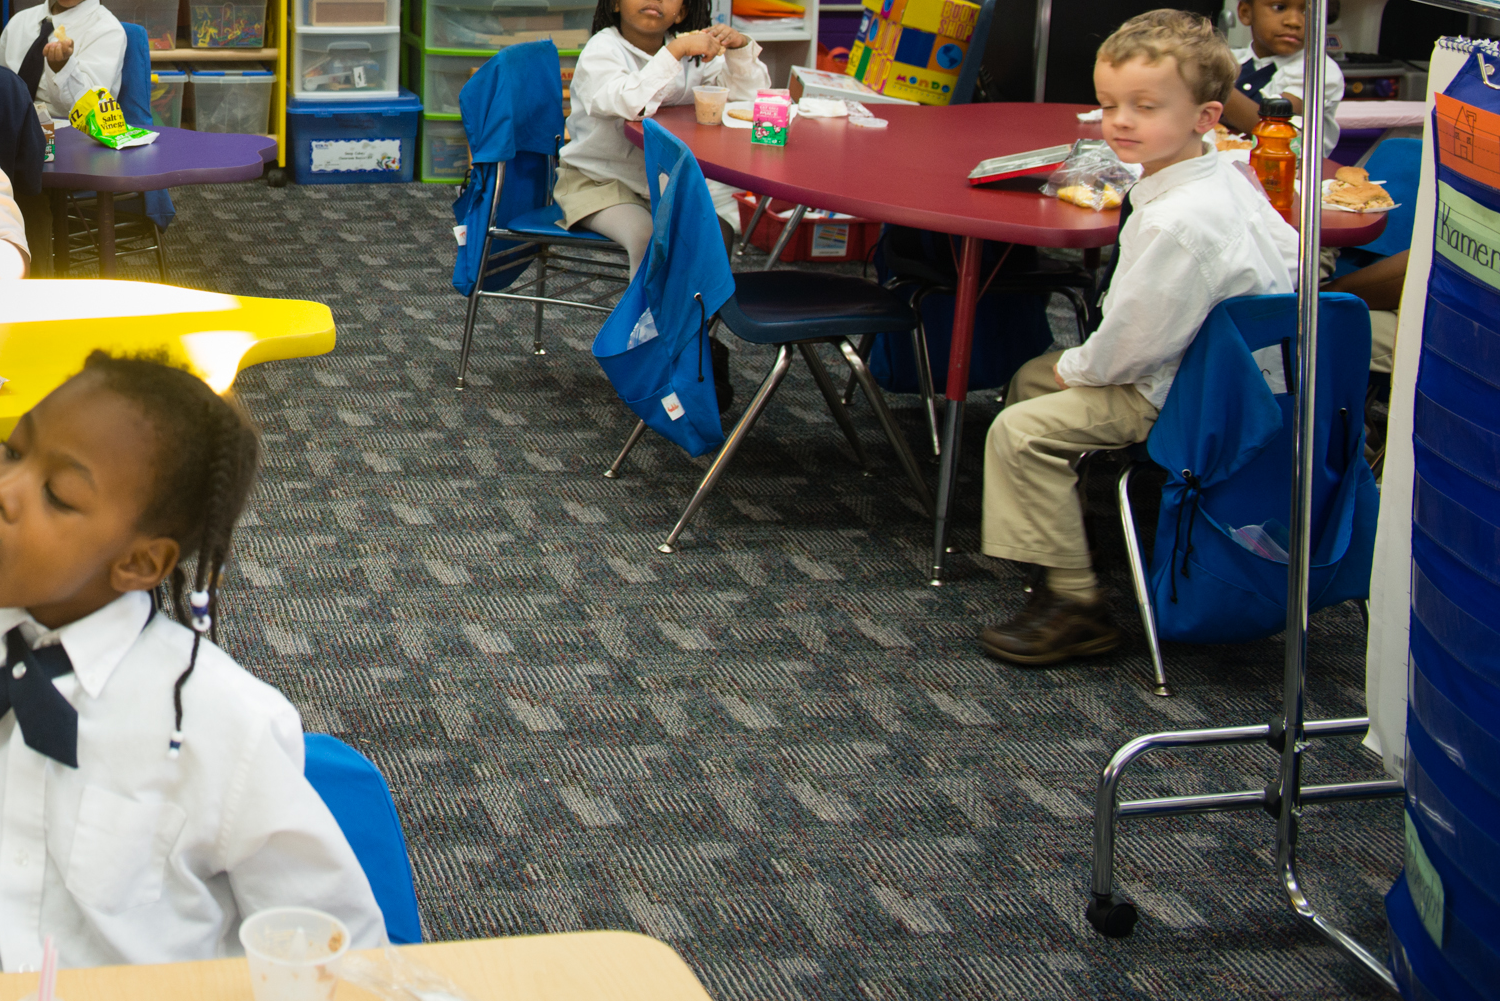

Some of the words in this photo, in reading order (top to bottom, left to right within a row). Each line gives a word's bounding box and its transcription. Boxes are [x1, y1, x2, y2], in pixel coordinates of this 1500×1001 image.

[941, 0, 978, 22] BOOK
[937, 19, 975, 41] SHOP
[102, 113, 117, 124] Salt
